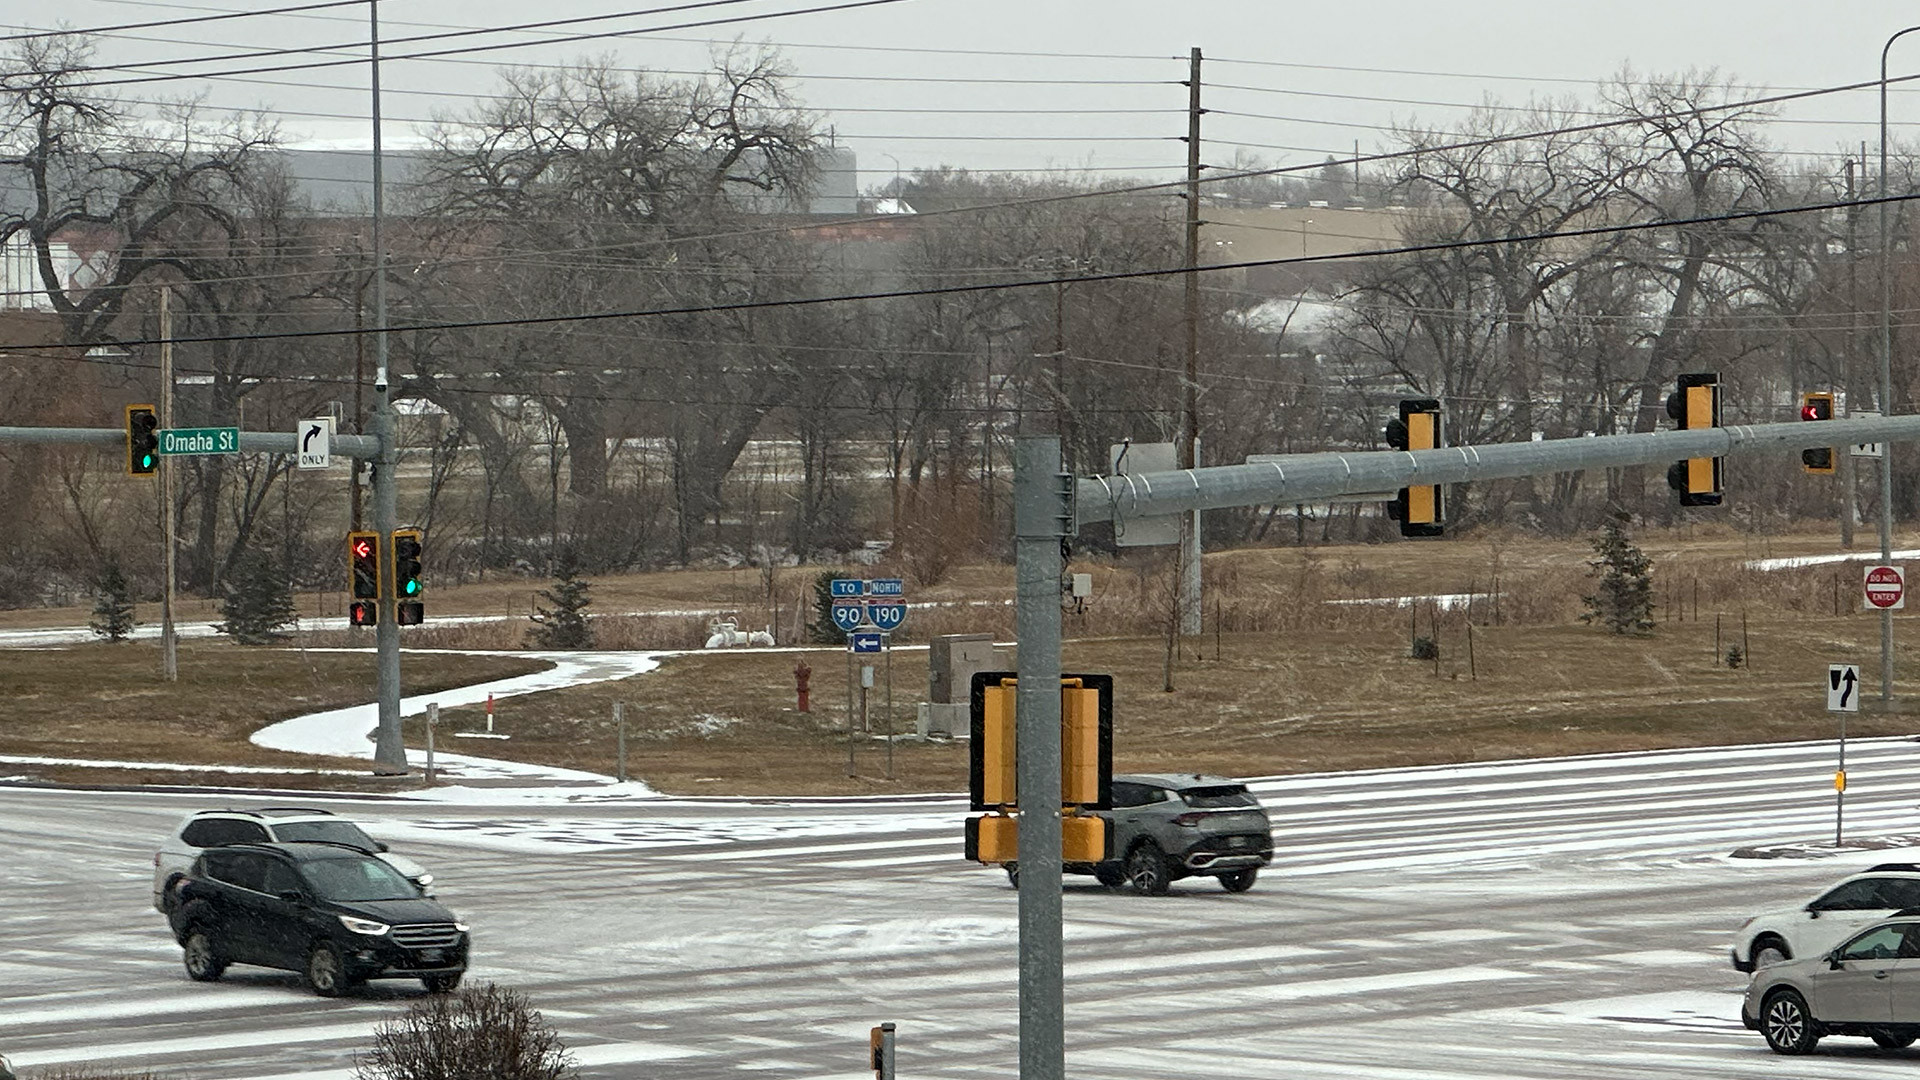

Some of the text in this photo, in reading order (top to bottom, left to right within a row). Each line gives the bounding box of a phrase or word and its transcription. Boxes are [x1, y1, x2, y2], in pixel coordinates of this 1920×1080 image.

[165, 431, 233, 452] Omaha St
[302, 454, 325, 465] ONLY
[839, 583, 855, 593] TO
[872, 583, 902, 593] NORTH
[1872, 593, 1895, 601] ENTER
[836, 608, 860, 623] 90
[876, 607, 900, 623] 190
